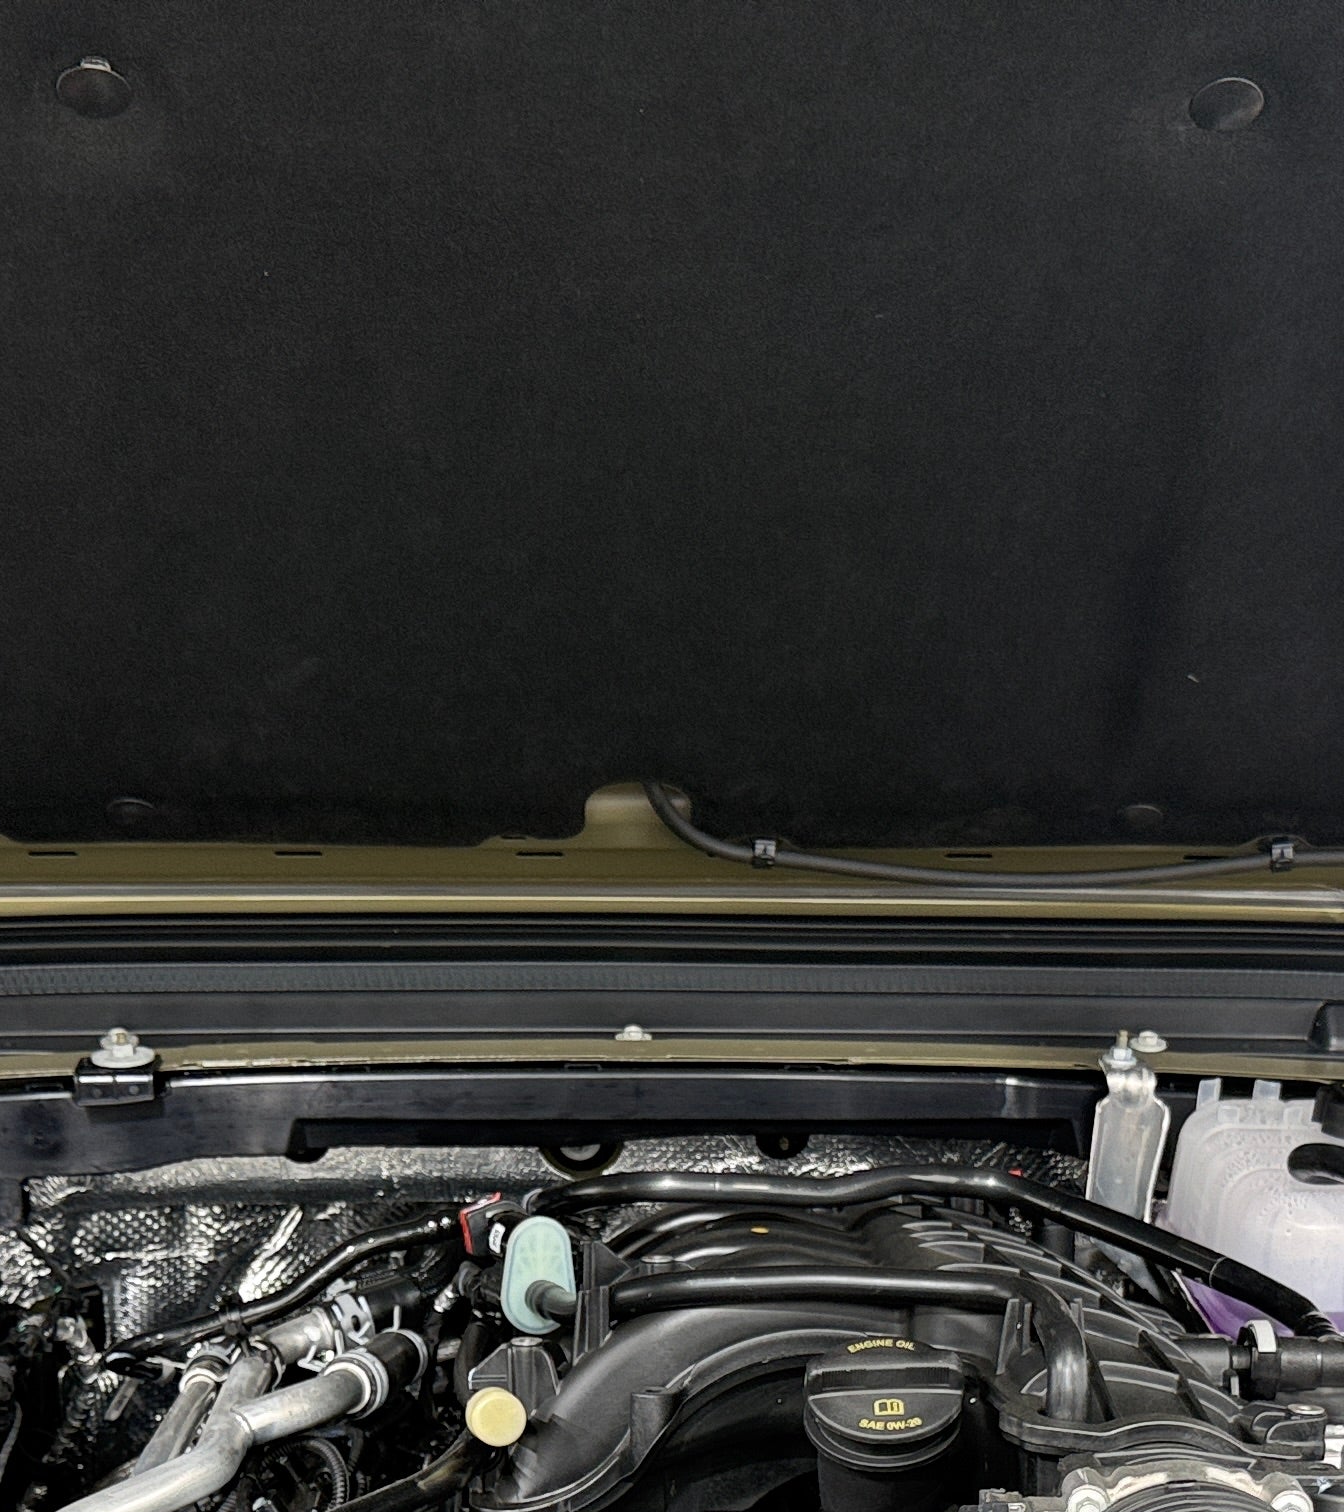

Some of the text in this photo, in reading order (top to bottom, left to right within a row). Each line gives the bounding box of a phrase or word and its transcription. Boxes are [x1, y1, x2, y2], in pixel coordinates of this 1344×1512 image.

[847, 1339, 915, 1353] ENGINE OIL
[859, 1417, 922, 1431] SAE 0W-20
